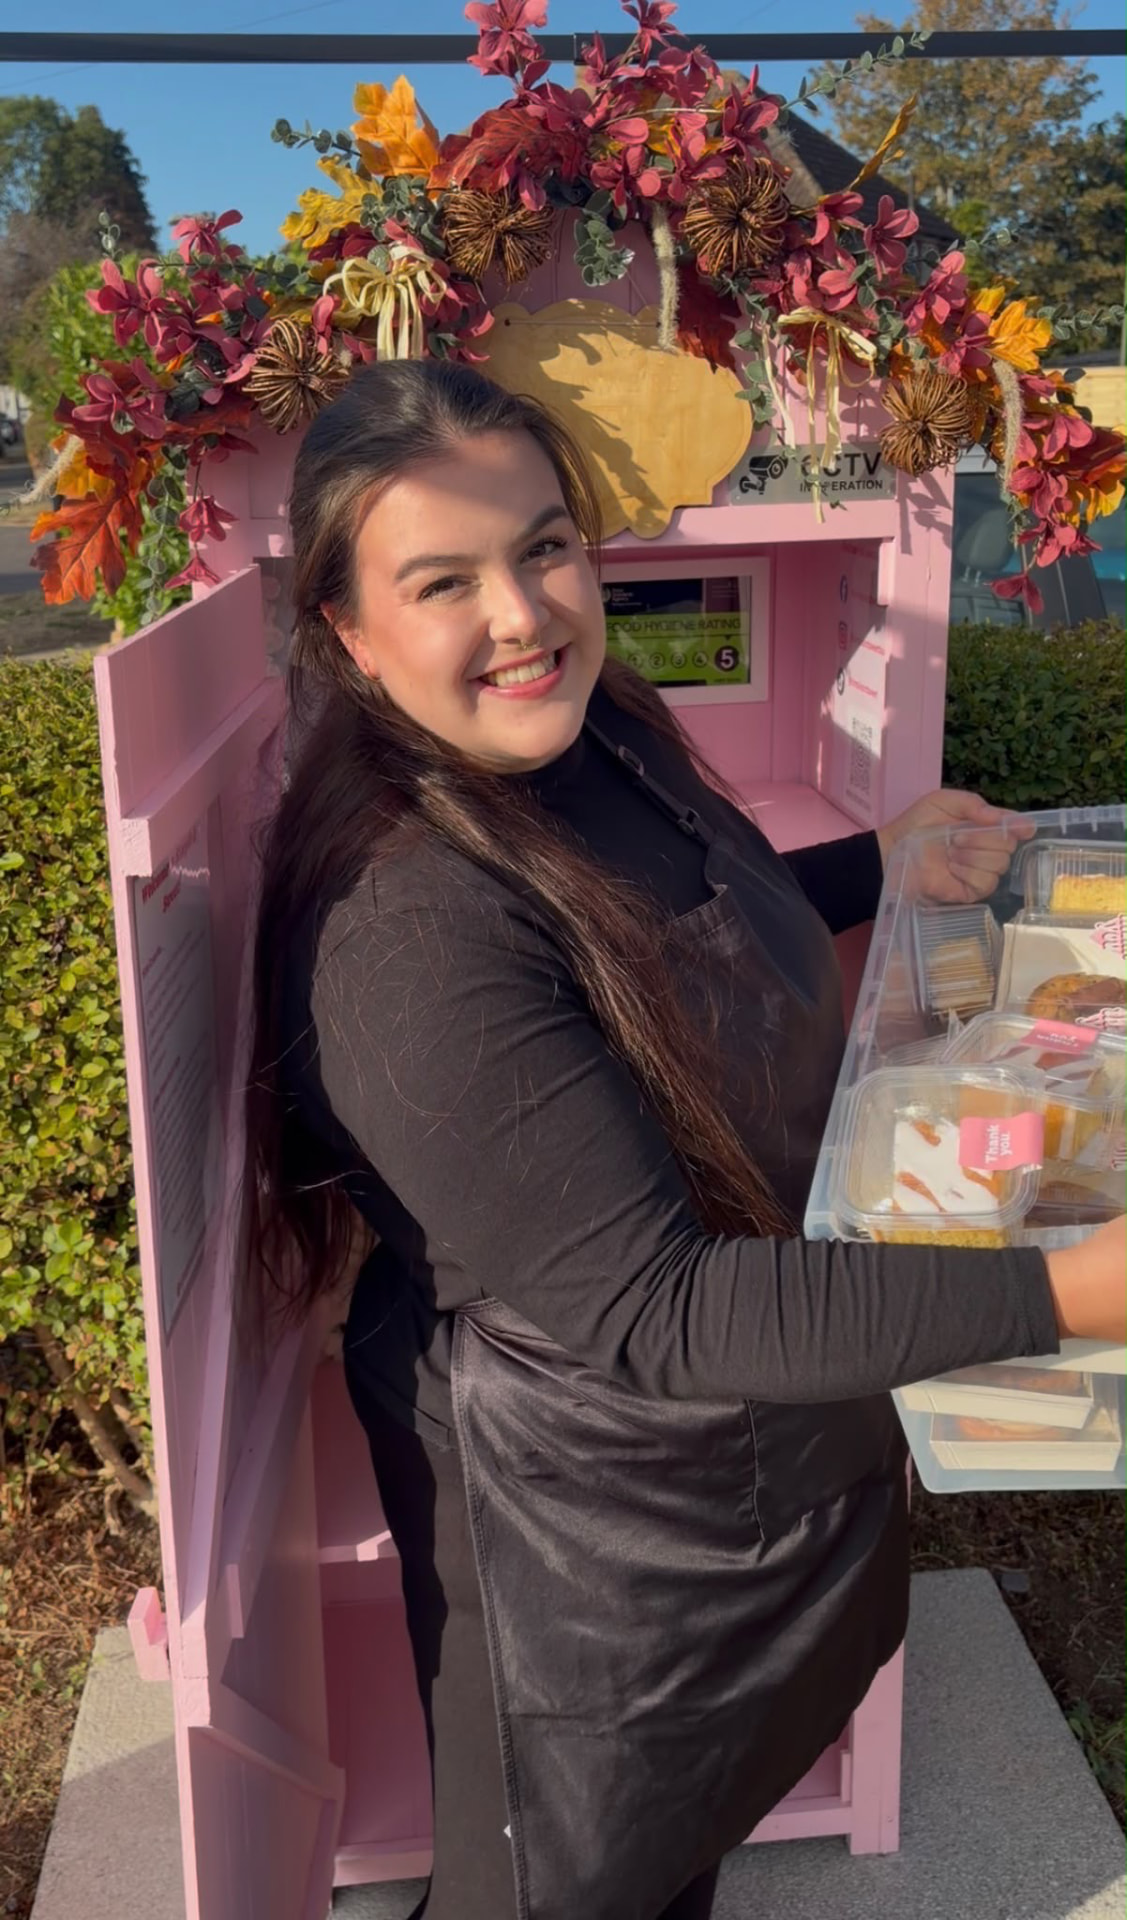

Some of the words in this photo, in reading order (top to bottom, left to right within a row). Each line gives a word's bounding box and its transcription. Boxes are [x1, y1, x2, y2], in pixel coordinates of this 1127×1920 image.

[607, 621, 642, 632] FOOD
[644, 619, 696, 631] HYGIENE
[698, 618, 741, 630] RATING
[719, 649, 734, 669] 5
[984, 1124, 1000, 1164] Thank
[1000, 1131, 1013, 1156] you
